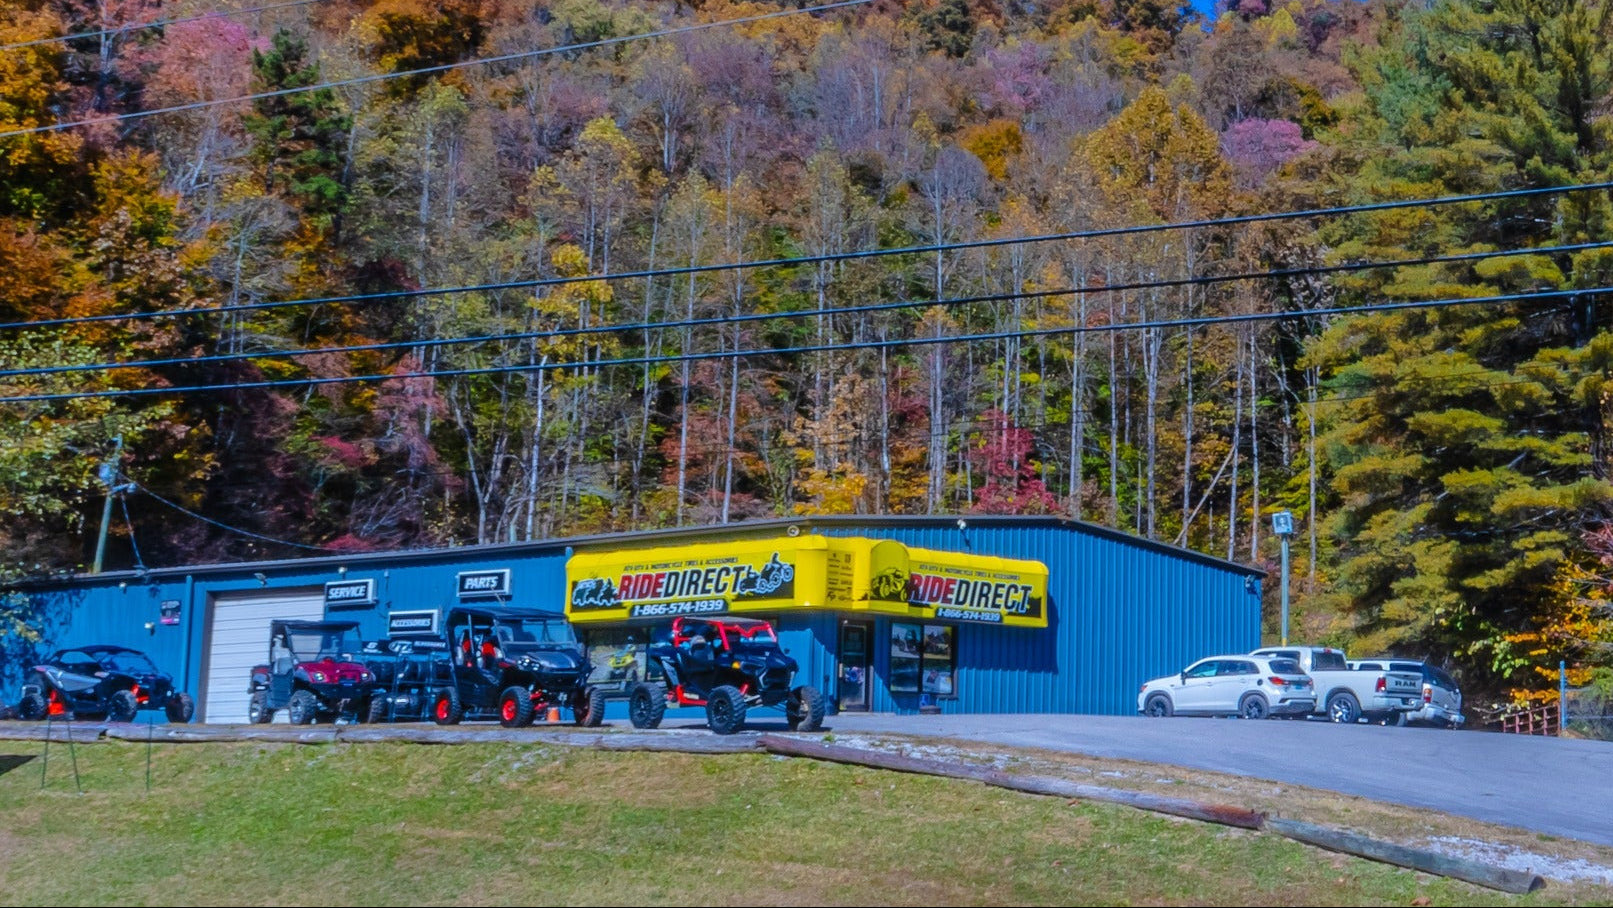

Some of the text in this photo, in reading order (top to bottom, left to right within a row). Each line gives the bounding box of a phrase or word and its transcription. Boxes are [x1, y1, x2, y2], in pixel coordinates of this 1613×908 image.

[464, 576, 499, 590] PARTS
[328, 585, 366, 599] SERVICE
[633, 600, 724, 616] 1-866-574-1939
[937, 608, 1000, 621] 1-866-574-1939
